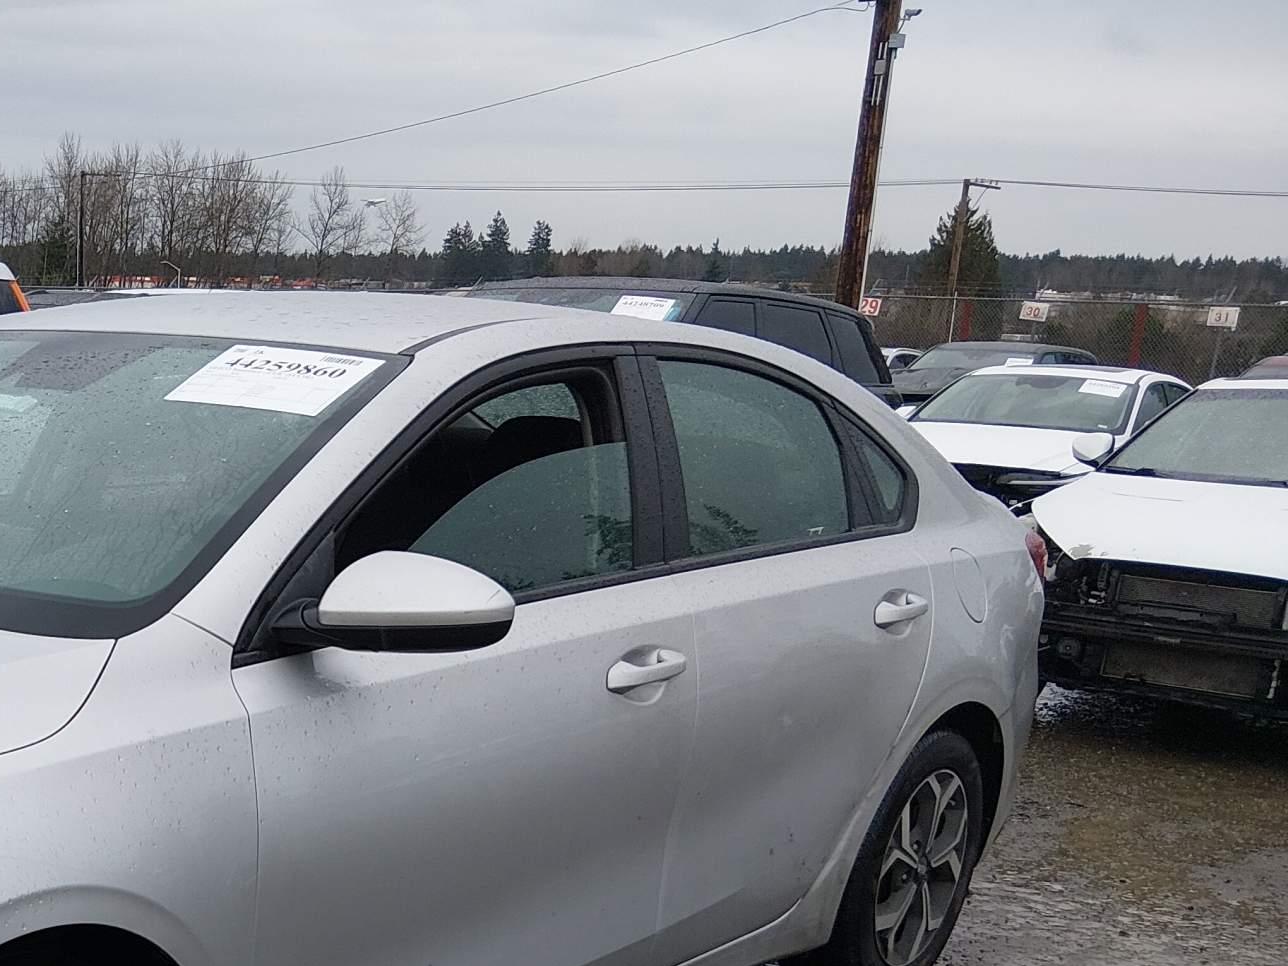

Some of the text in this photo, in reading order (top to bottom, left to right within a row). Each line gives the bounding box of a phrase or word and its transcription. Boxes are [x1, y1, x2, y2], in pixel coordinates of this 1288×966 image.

[860, 299, 879, 314] 29
[1026, 306, 1041, 317] 30
[1214, 311, 1229, 323] 31
[224, 356, 348, 379] 44259860
